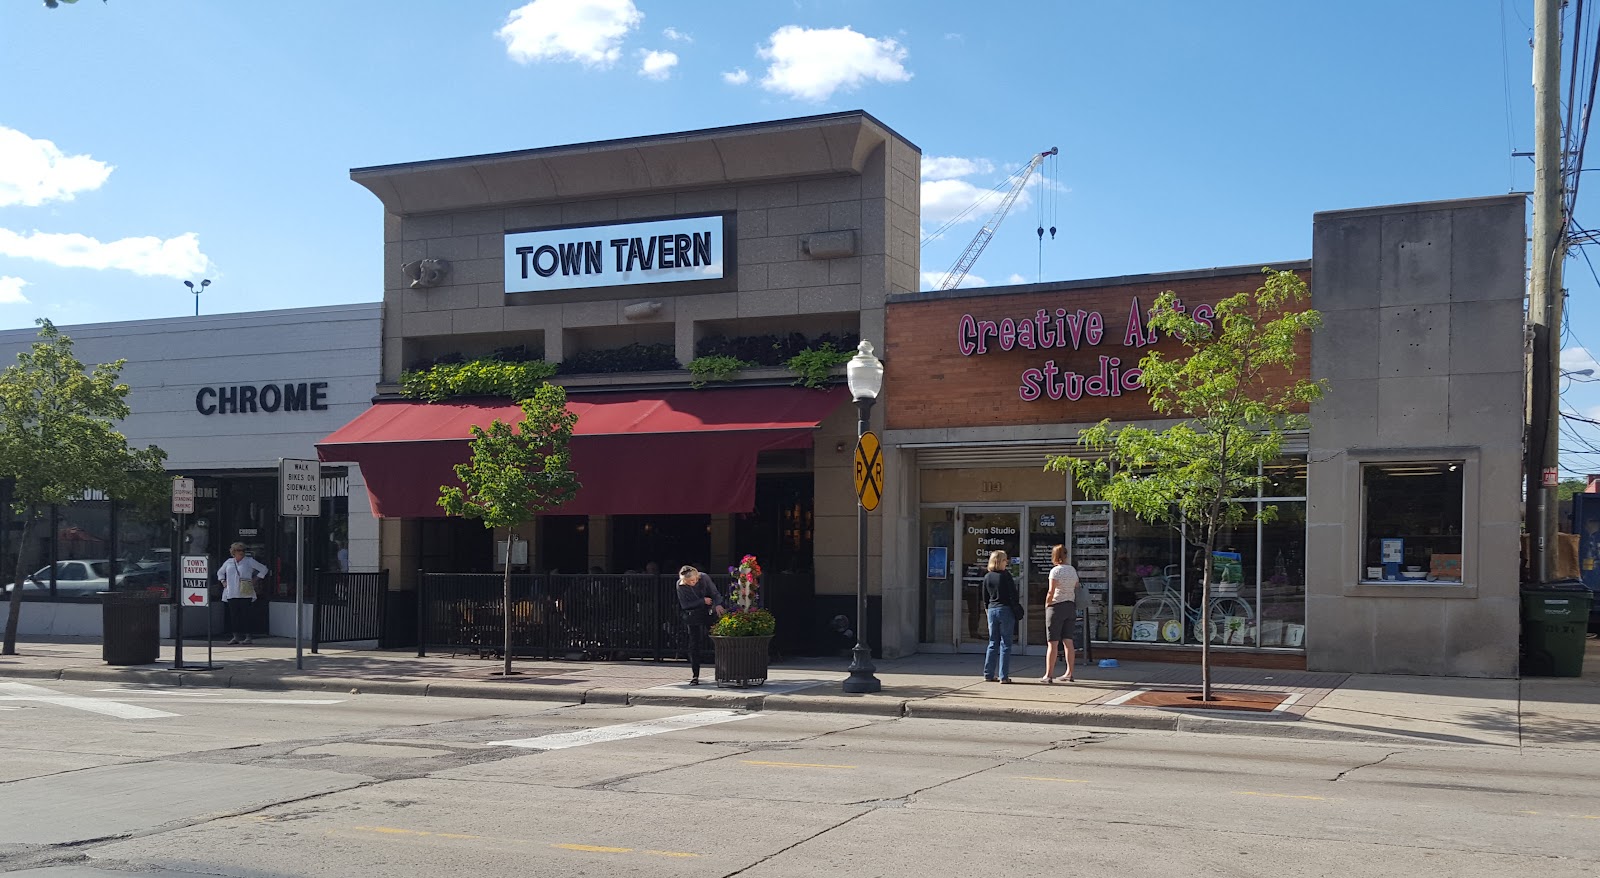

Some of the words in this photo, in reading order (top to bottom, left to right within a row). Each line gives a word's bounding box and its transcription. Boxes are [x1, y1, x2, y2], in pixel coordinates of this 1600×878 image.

[515, 240, 603, 279] TOWN
[610, 231, 712, 273] TAVERN
[957, 307, 1104, 357] Creative
[195, 381, 329, 416] CHROME
[294, 463, 309, 472] WALK
[288, 473, 305, 481] BIKES
[307, 474, 315, 482] ON
[286, 483, 317, 492] SIDEWALKS
[320, 476, 348, 497] HROME
[982, 481, 1002, 492] 114
[286, 493, 299, 502] CITY
[301, 494, 316, 502] CODE
[292, 504, 310, 512] 650-3
[967, 526, 989, 536] Open
[990, 526, 1016, 535] Studio
[977, 537, 1005, 545] Parties
[184, 579, 207, 588] VALET
